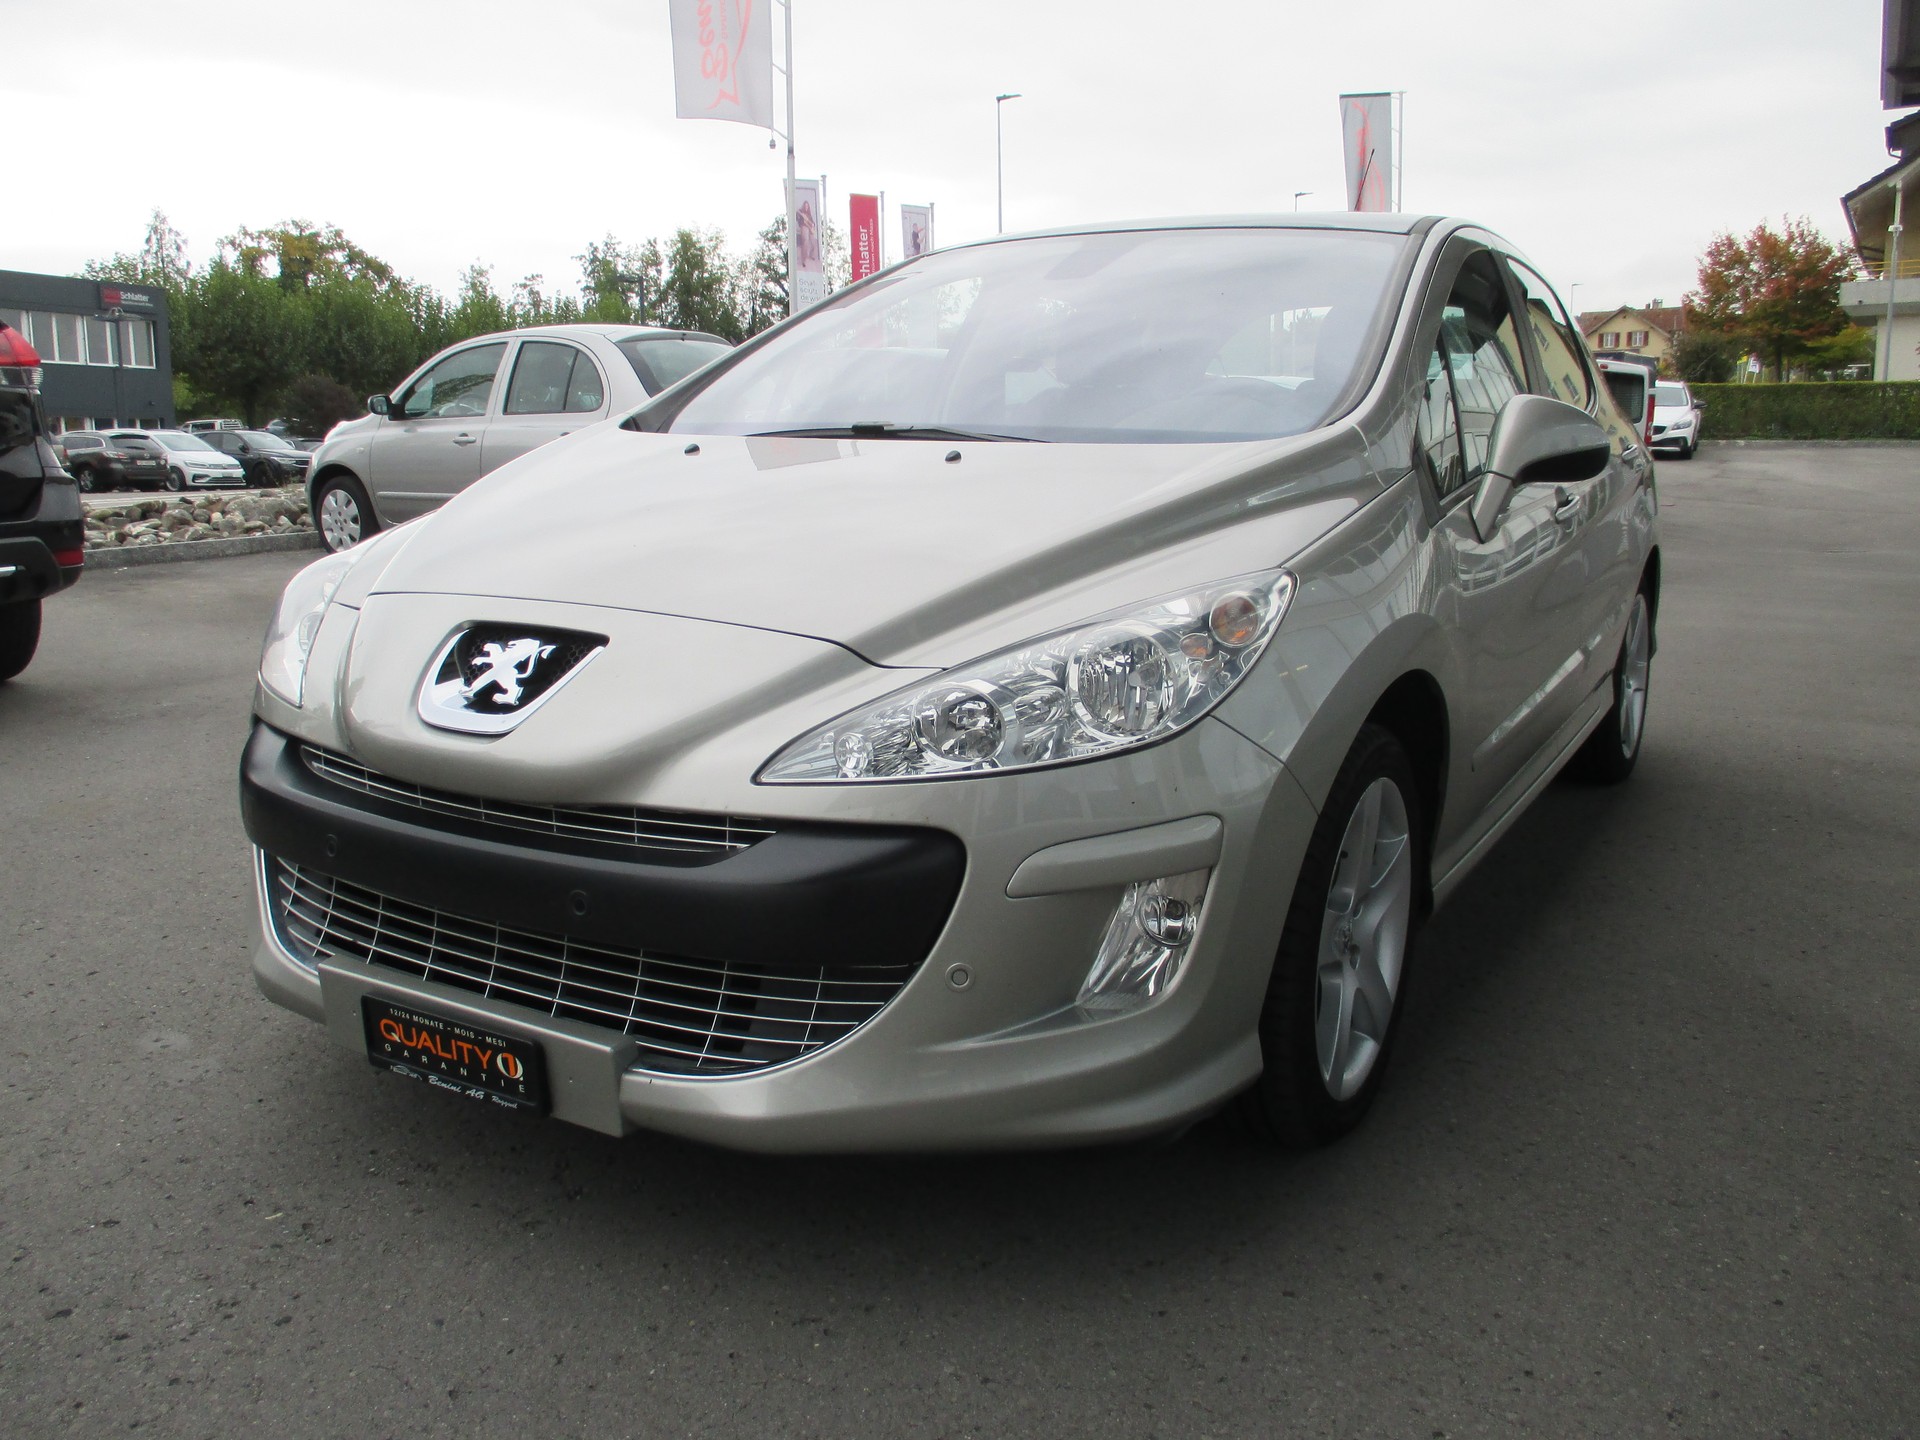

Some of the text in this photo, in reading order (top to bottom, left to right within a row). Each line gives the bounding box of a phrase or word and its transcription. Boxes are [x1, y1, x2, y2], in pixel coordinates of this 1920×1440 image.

[859, 225, 870, 278] chlatter
[120, 291, 150, 302] Schlatter
[379, 1018, 492, 1070] QUALITY
[389, 1008, 507, 1047] 12/24 MONATE MOIS MESI
[385, 1043, 525, 1093] GARANTIE
[465, 1088, 485, 1100] AG
